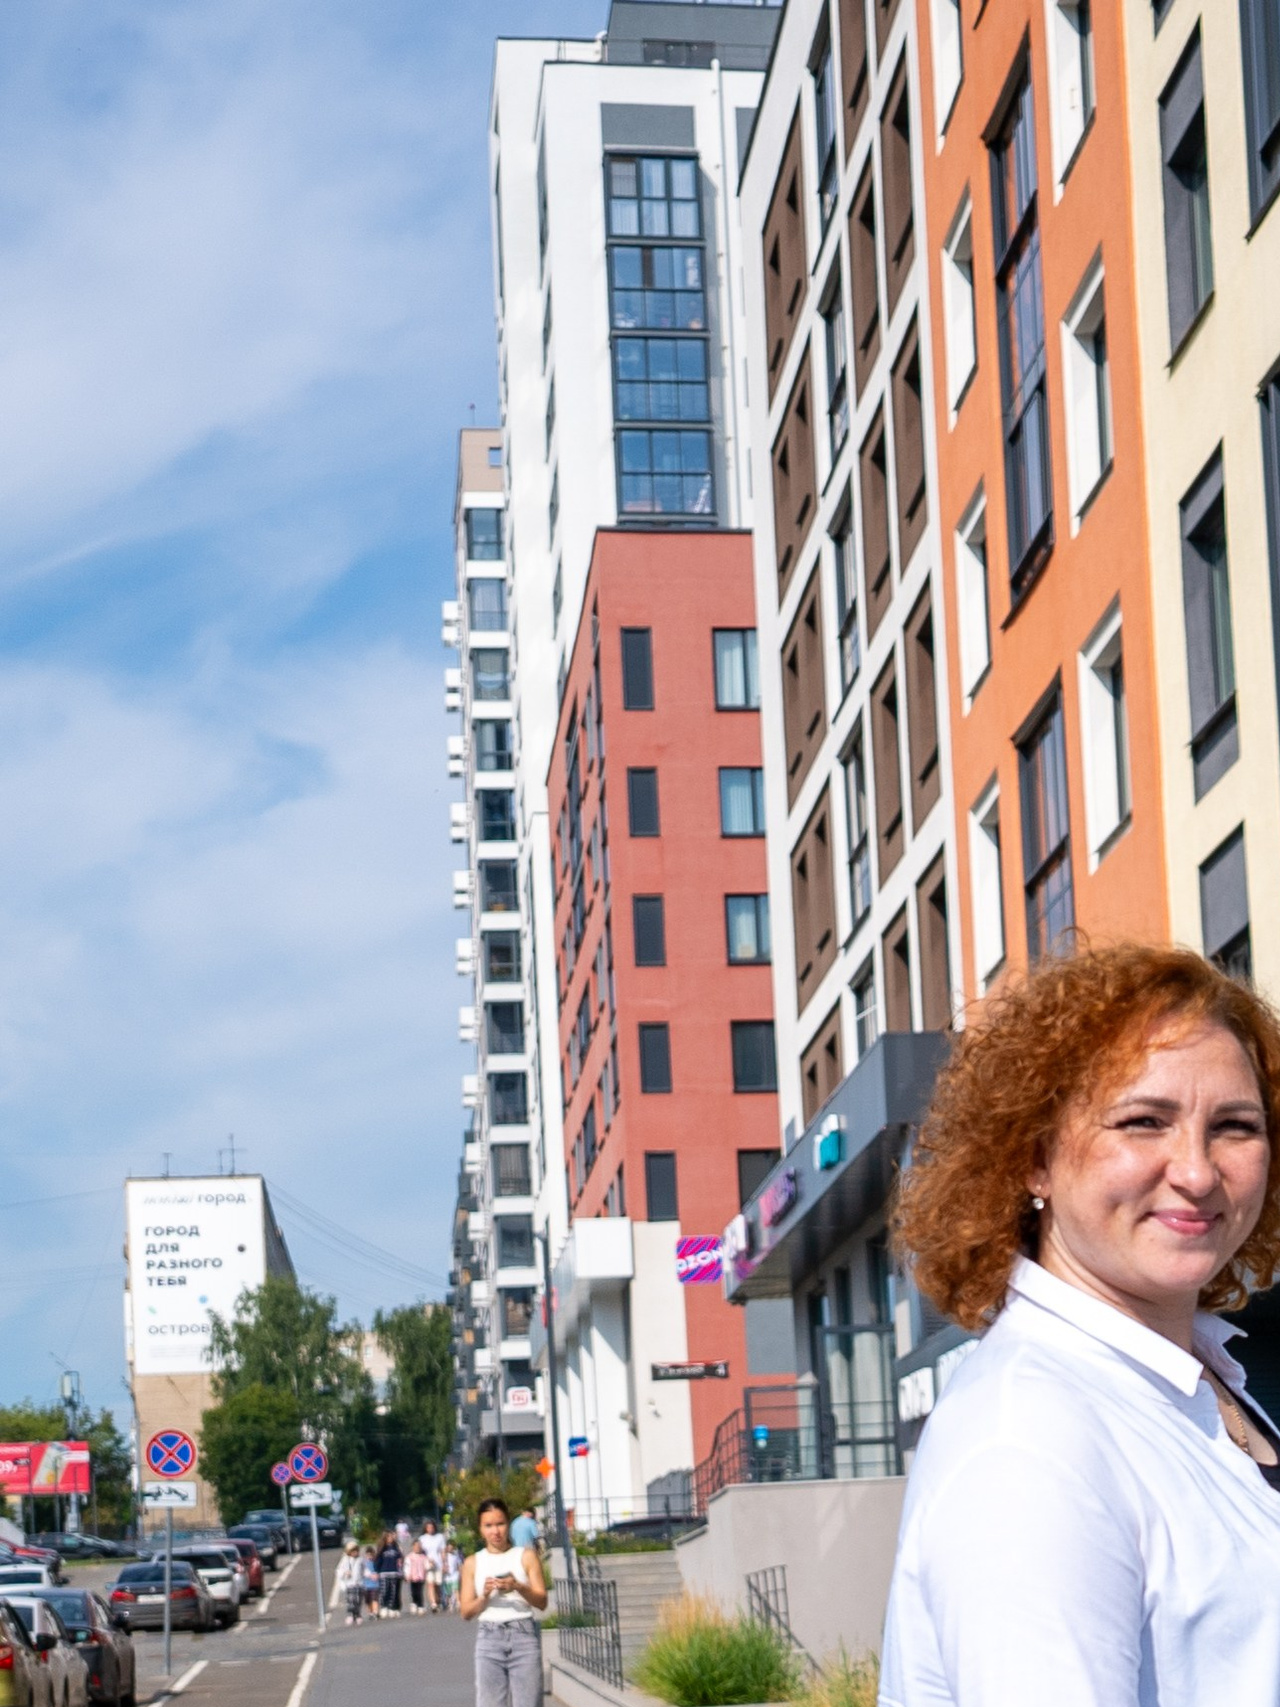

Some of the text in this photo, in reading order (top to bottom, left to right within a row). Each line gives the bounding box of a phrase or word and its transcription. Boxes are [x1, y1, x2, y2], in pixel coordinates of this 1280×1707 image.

[145, 1225, 201, 1237] ГОРОД
[146, 1243, 180, 1255] ДЛЯ
[146, 1257, 223, 1270] РАЗНОГО
[147, 1275, 187, 1287] ТЕБЯ
